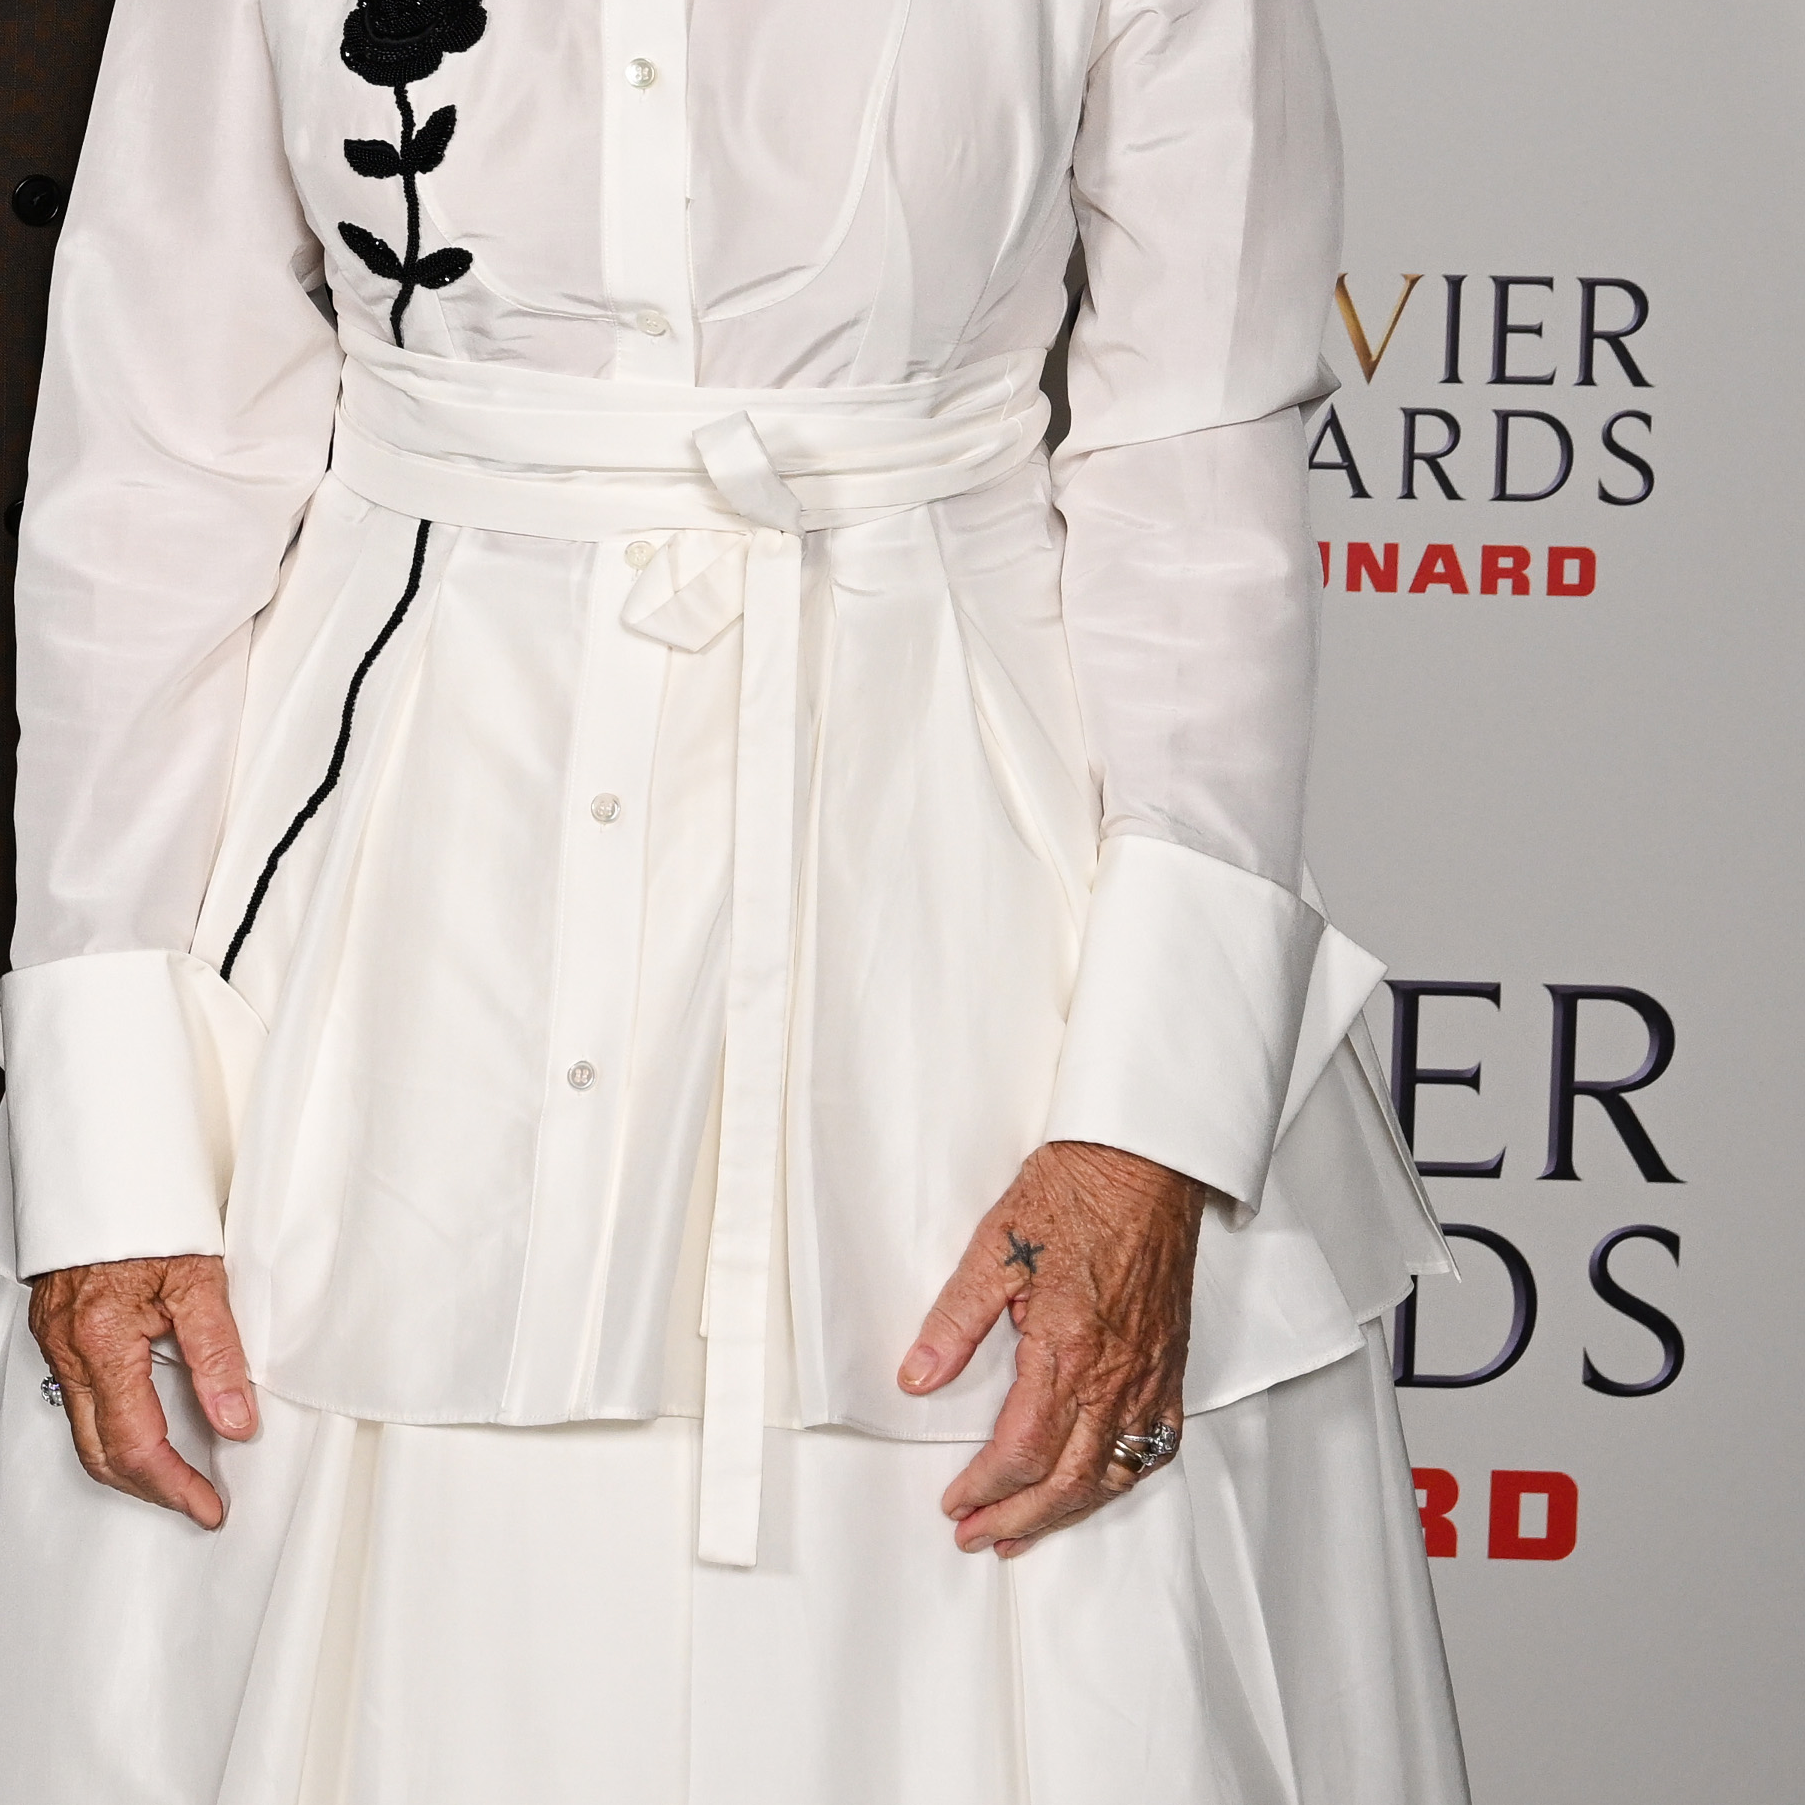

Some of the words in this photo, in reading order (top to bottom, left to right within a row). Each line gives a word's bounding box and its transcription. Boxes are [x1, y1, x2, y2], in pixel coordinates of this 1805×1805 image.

[1334, 272, 1656, 388] VIER
[1308, 402, 1655, 507] ARDS
[1317, 540, 1597, 597] NARD
